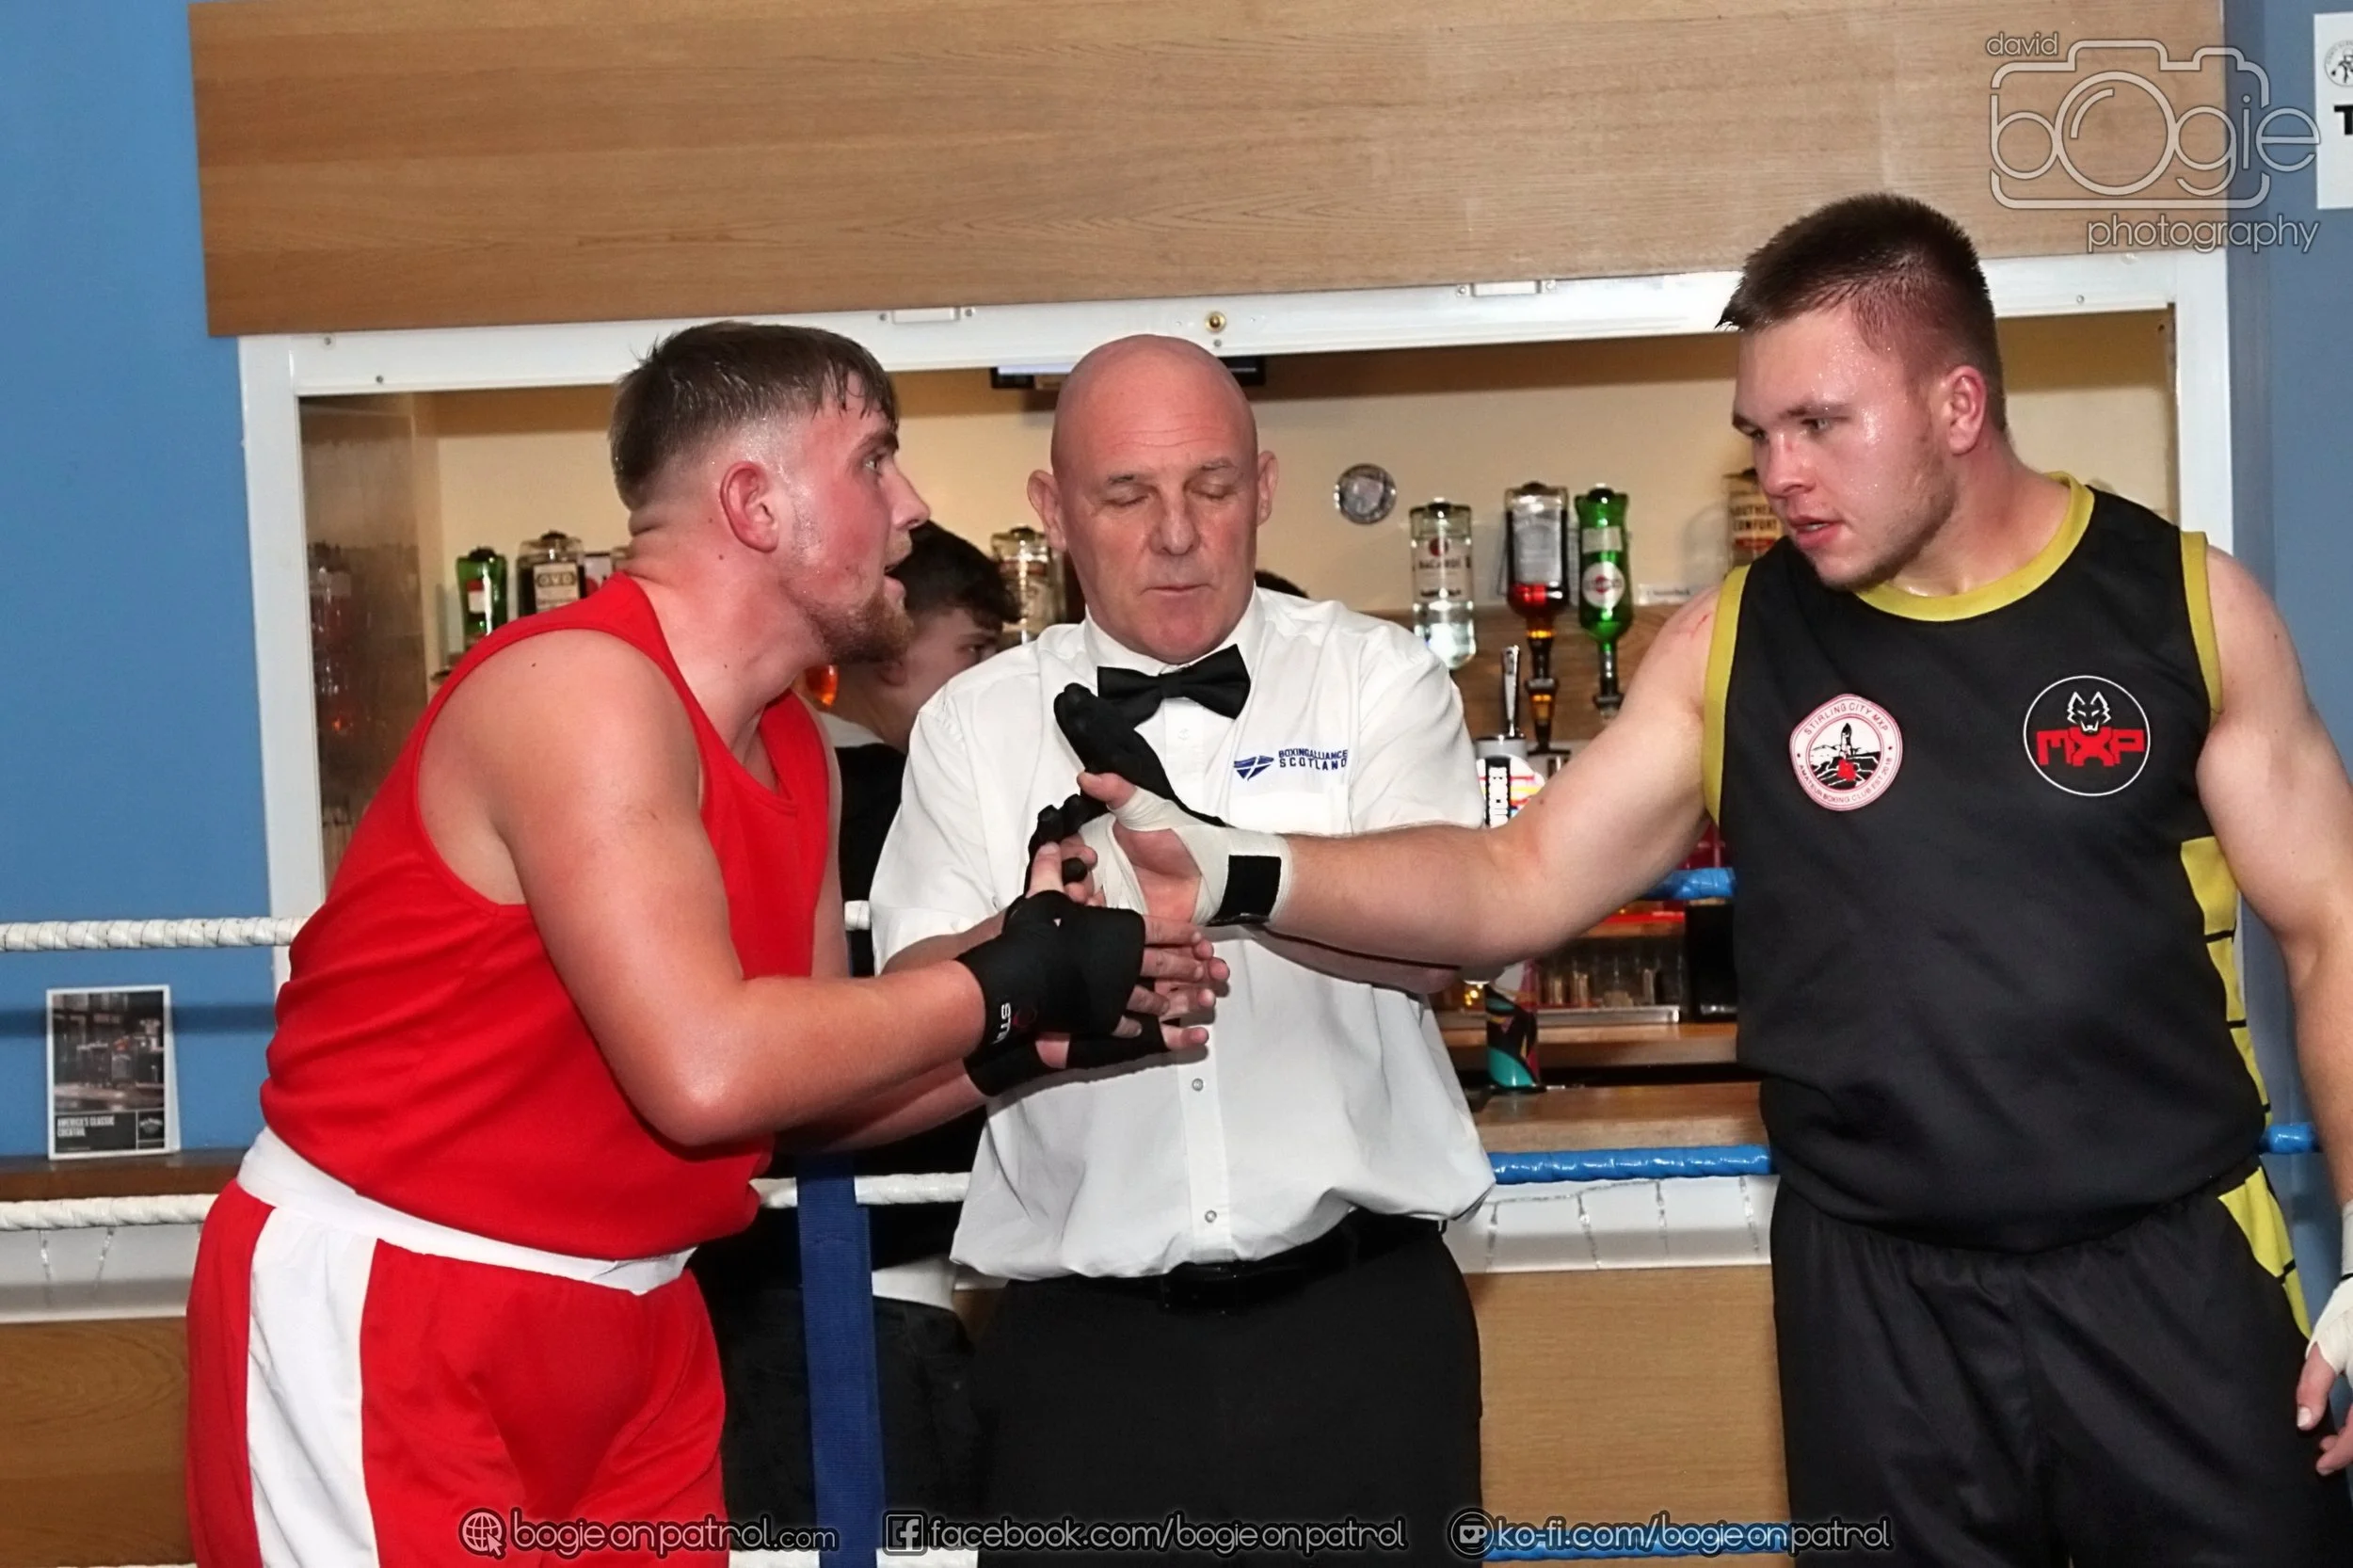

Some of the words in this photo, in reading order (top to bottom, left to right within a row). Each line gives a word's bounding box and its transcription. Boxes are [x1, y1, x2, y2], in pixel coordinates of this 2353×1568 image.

[1804, 703, 1847, 735] STIRLING
[1849, 702, 1873, 715] CITY
[1872, 713, 1888, 732] MXP
[2036, 726, 2145, 767] MXP
[1279, 758, 1347, 770] SCOTLAND
[1799, 764, 1823, 797] AMATEUR
[1822, 792, 1850, 804] BOXING
[1851, 787, 1872, 801] CLUB
[1870, 775, 1883, 791] EST
[89, 1115, 115, 1127] CLASSIC
